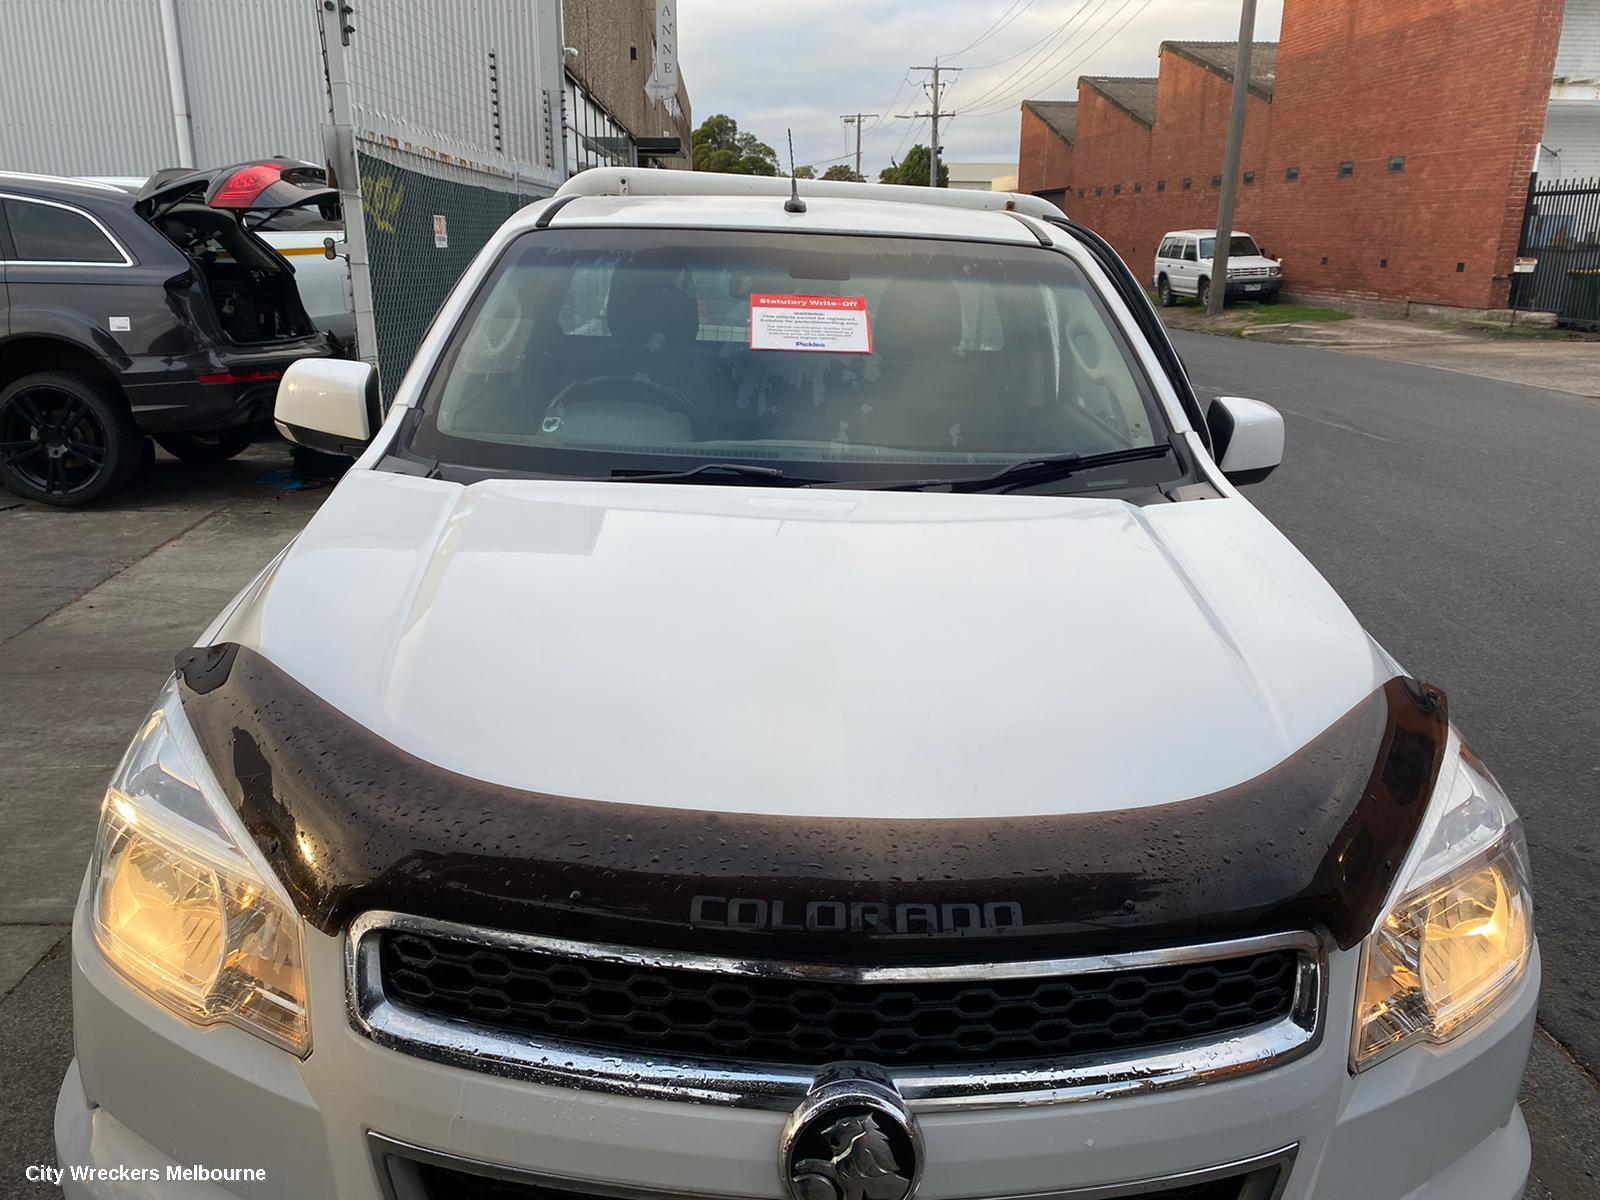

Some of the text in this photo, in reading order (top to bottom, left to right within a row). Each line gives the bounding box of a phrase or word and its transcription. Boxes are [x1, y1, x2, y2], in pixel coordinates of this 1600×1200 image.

[759, 298, 858, 308] Statutory Write-Off
[690, 895, 1024, 935] COLORADO
